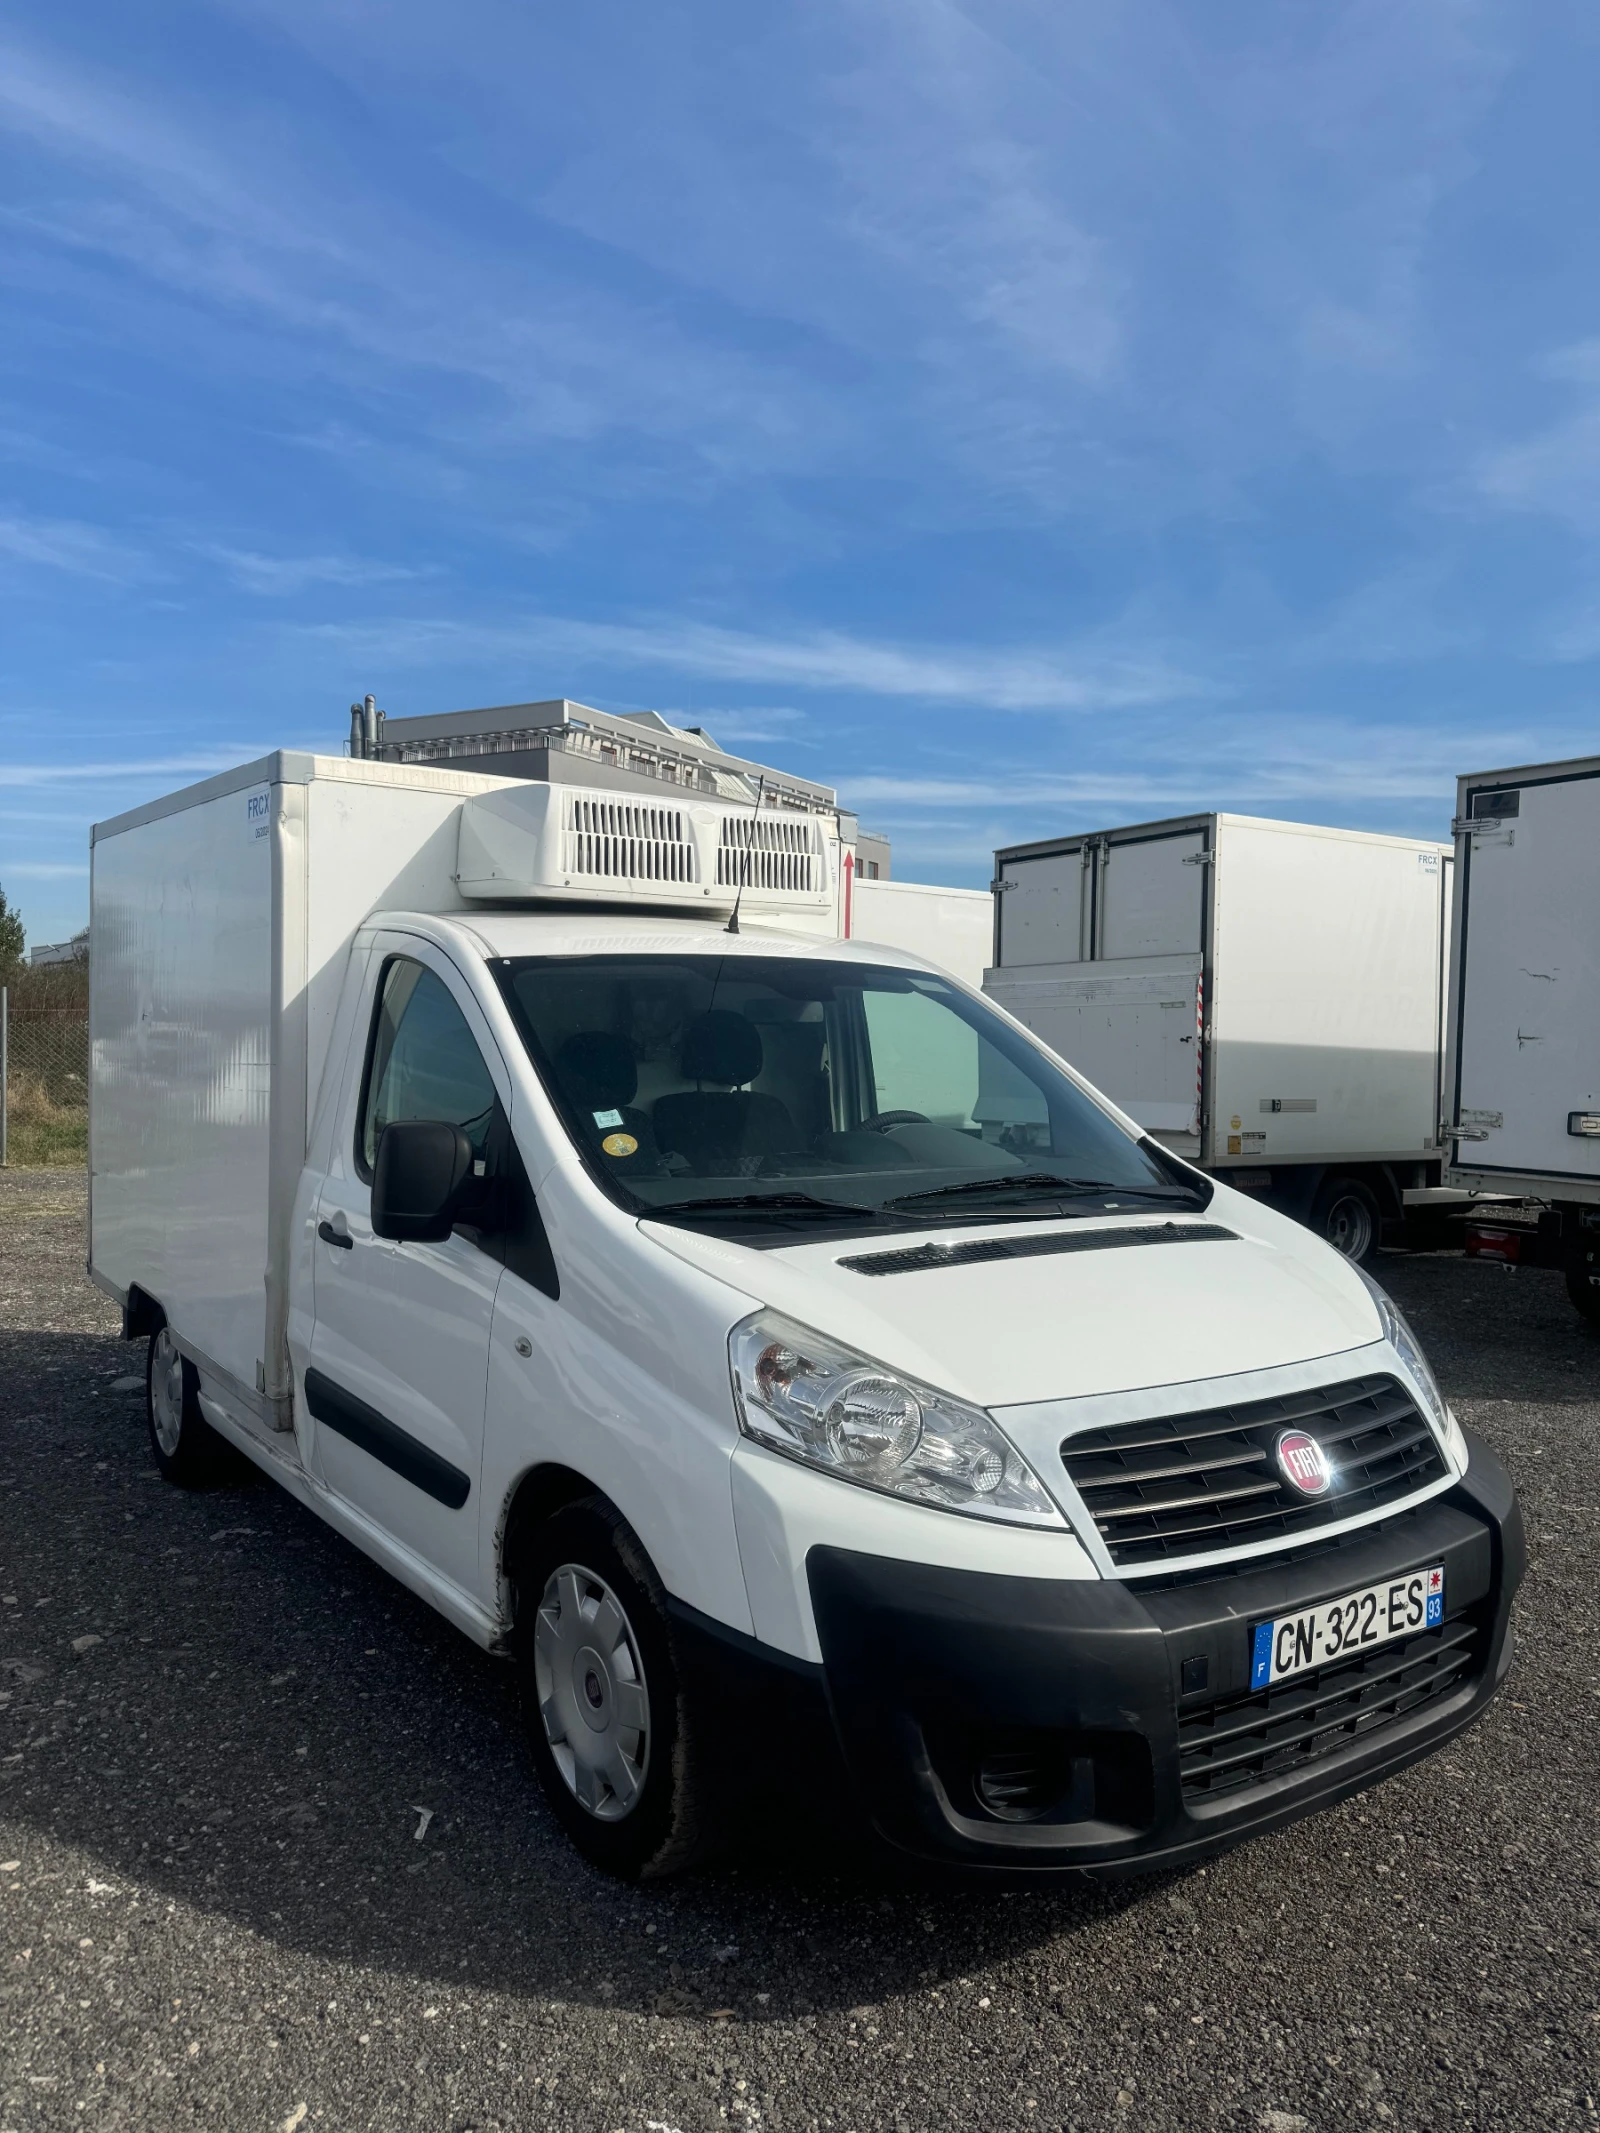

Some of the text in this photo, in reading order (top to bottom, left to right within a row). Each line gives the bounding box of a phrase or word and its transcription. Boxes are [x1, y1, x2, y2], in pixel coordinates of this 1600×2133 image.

[248, 793, 270, 820] FRCX
[1418, 854, 1438, 865] FRCX
[1287, 1446, 1321, 1480] FIAT
[1428, 1597, 1441, 1620] 93
[1275, 1578, 1424, 1674] CN-322-ES
[1257, 1662, 1265, 1678] F
